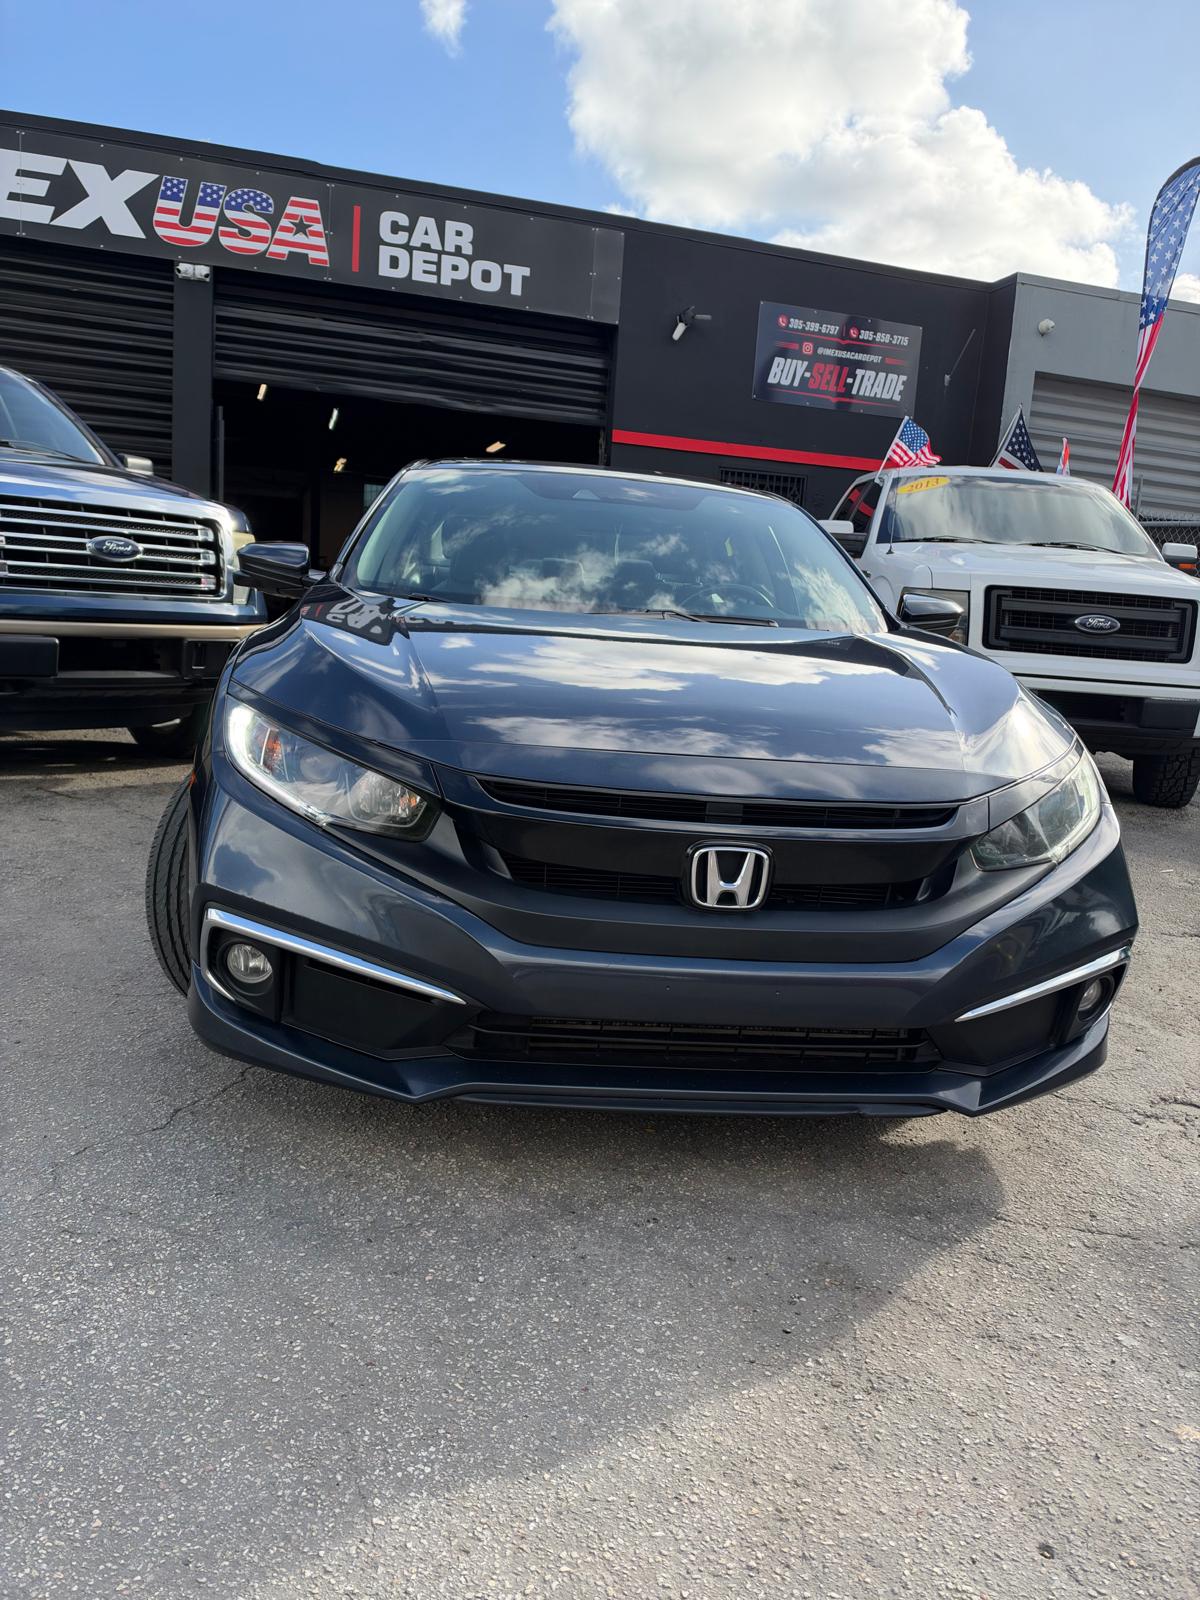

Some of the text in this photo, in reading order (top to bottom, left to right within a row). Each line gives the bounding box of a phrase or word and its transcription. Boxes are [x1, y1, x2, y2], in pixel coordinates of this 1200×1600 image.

[379, 210, 474, 255] CAR
[378, 245, 531, 296] DEPOT
[788, 318, 840, 335] 305-399-6797
[102, 539, 133, 555] Ford
[1086, 617, 1112, 630] Ford
